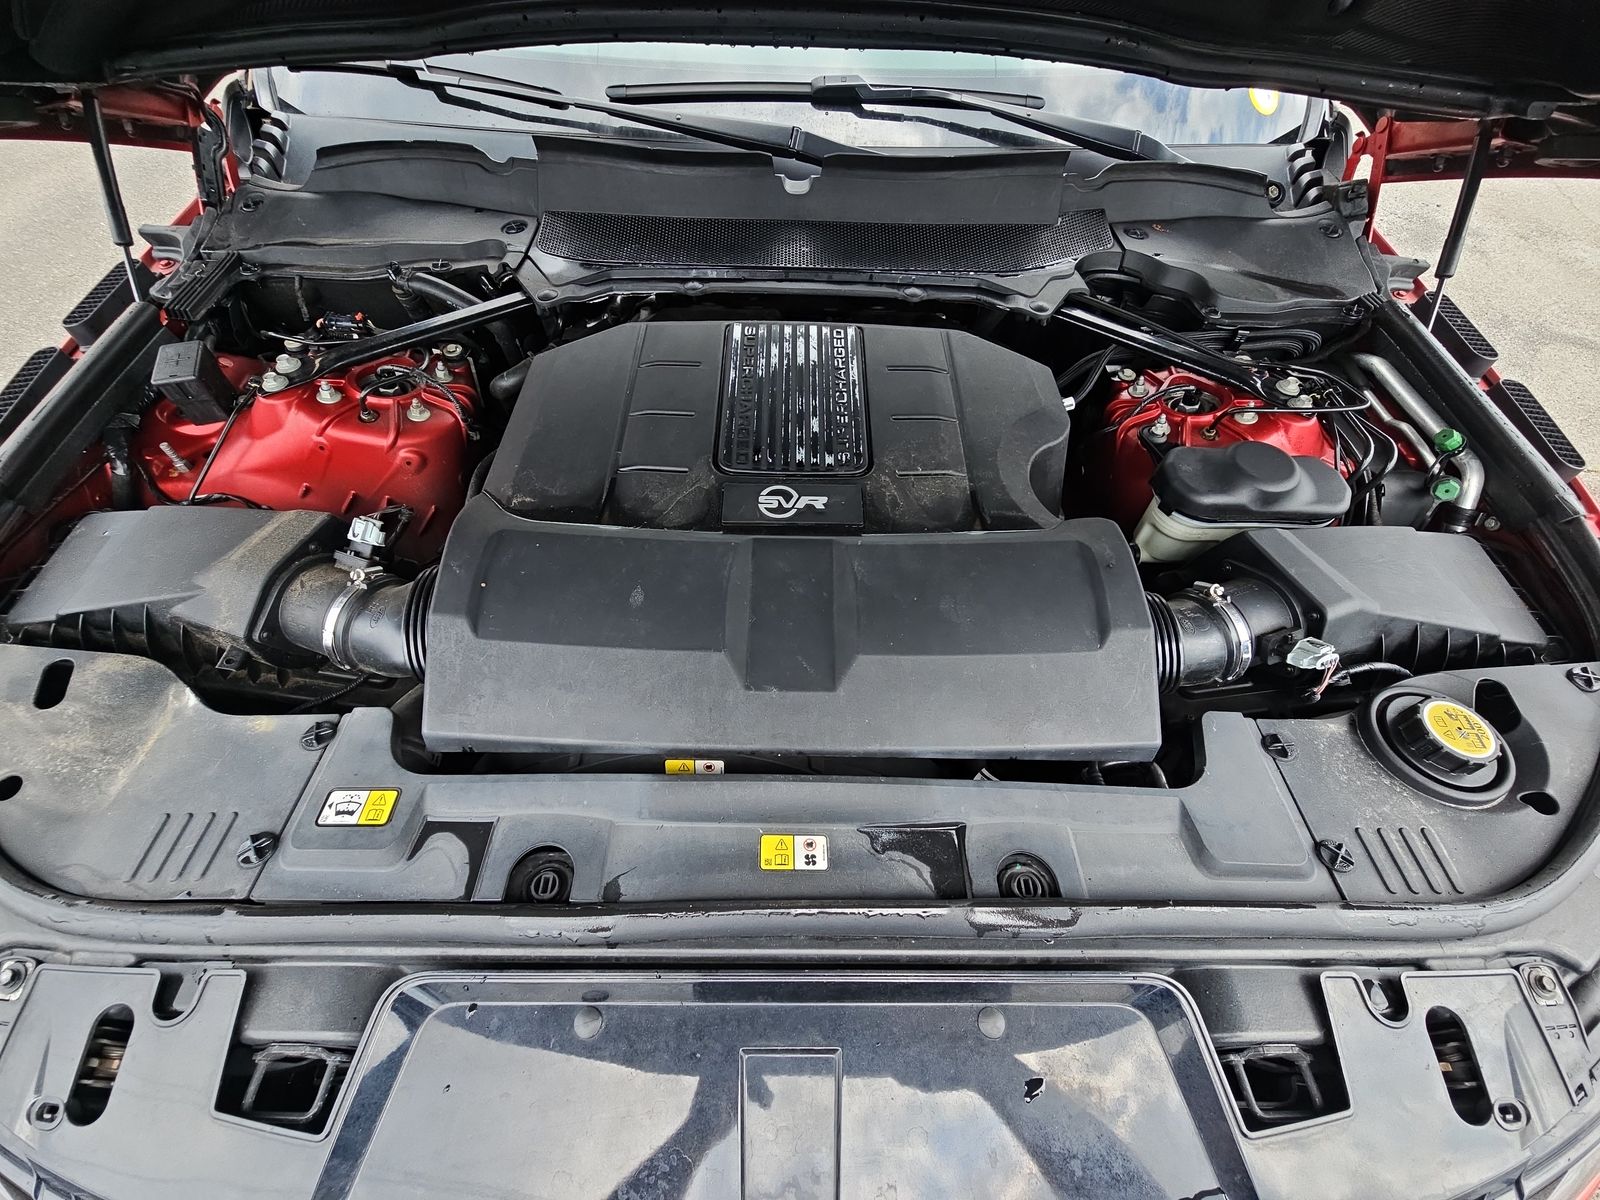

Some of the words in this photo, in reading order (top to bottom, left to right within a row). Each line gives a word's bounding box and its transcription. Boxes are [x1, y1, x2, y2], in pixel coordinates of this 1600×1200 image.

[736, 325, 756, 465] SUPERCHARGED
[833, 328, 851, 465] SUPERCHARGED
[758, 485, 828, 518] SVR
